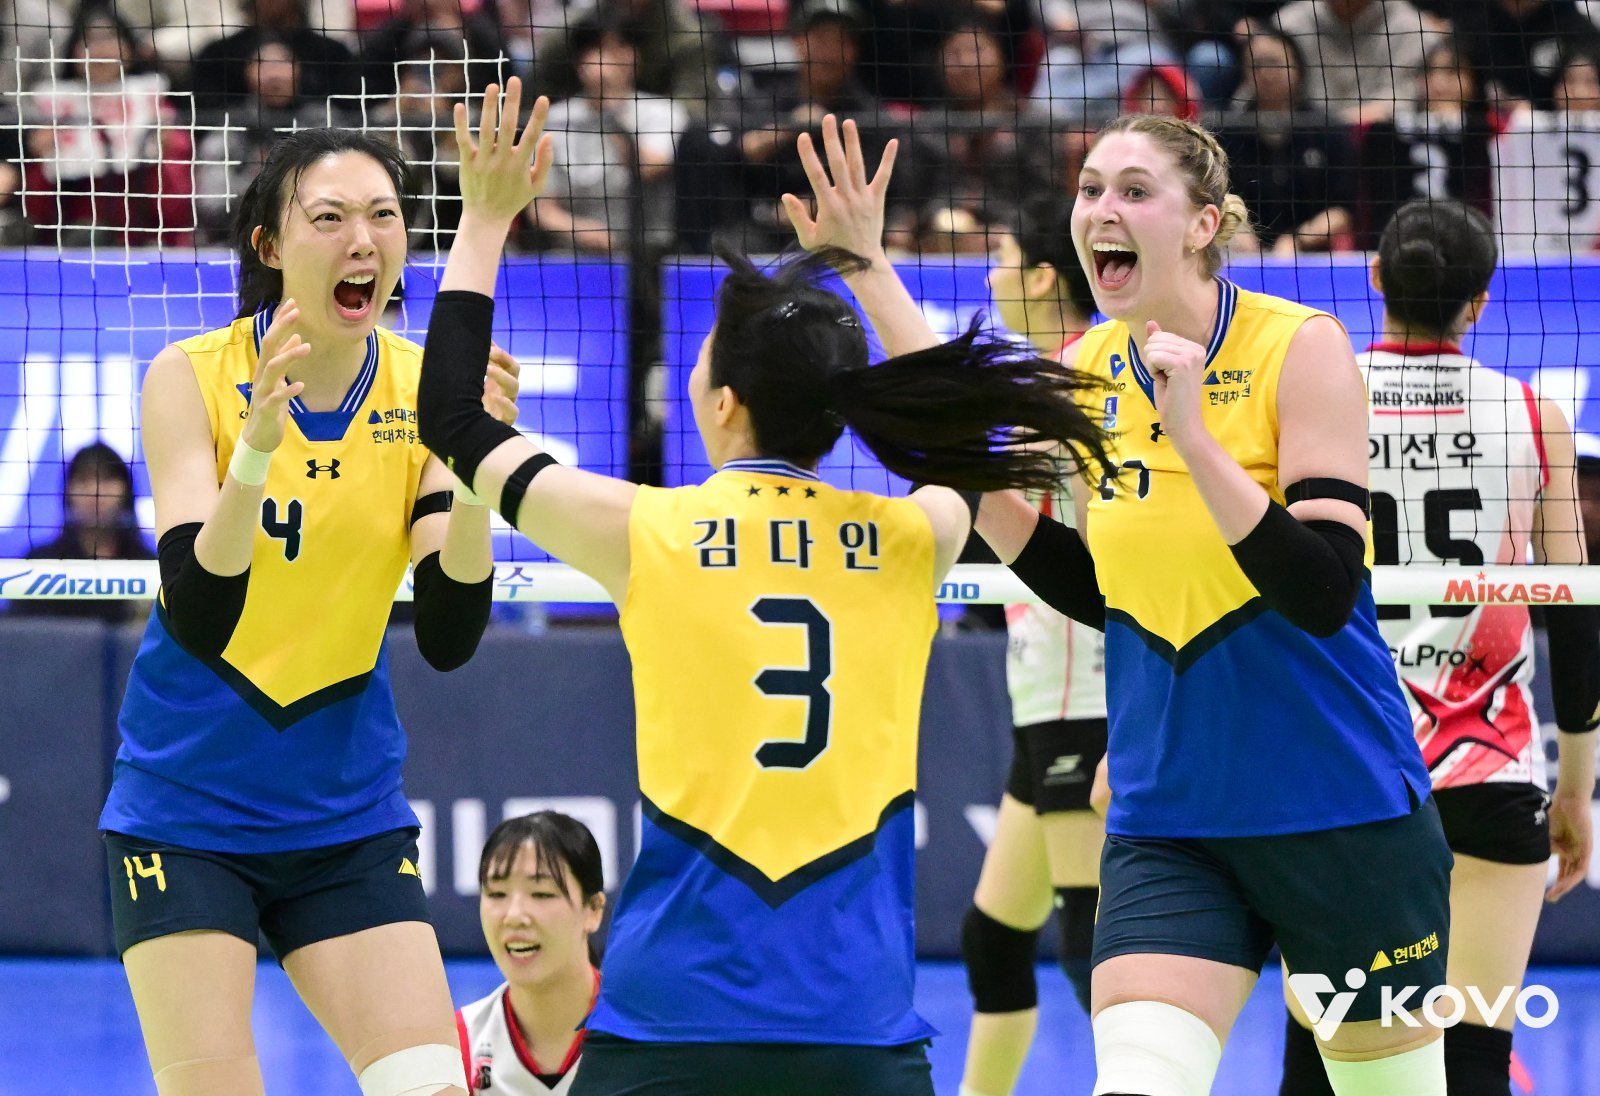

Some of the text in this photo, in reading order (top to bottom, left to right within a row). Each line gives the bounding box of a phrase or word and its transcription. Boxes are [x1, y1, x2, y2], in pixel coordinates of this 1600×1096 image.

[1561, 147, 1590, 216] 3
[1372, 388, 1465, 406] RED SPARKS
[1369, 431, 1484, 470] 이선우
[692, 517, 880, 571] 김다인
[749, 596, 833, 770] 3
[123, 851, 167, 902] 14
[1393, 931, 1440, 965] 현대건설
